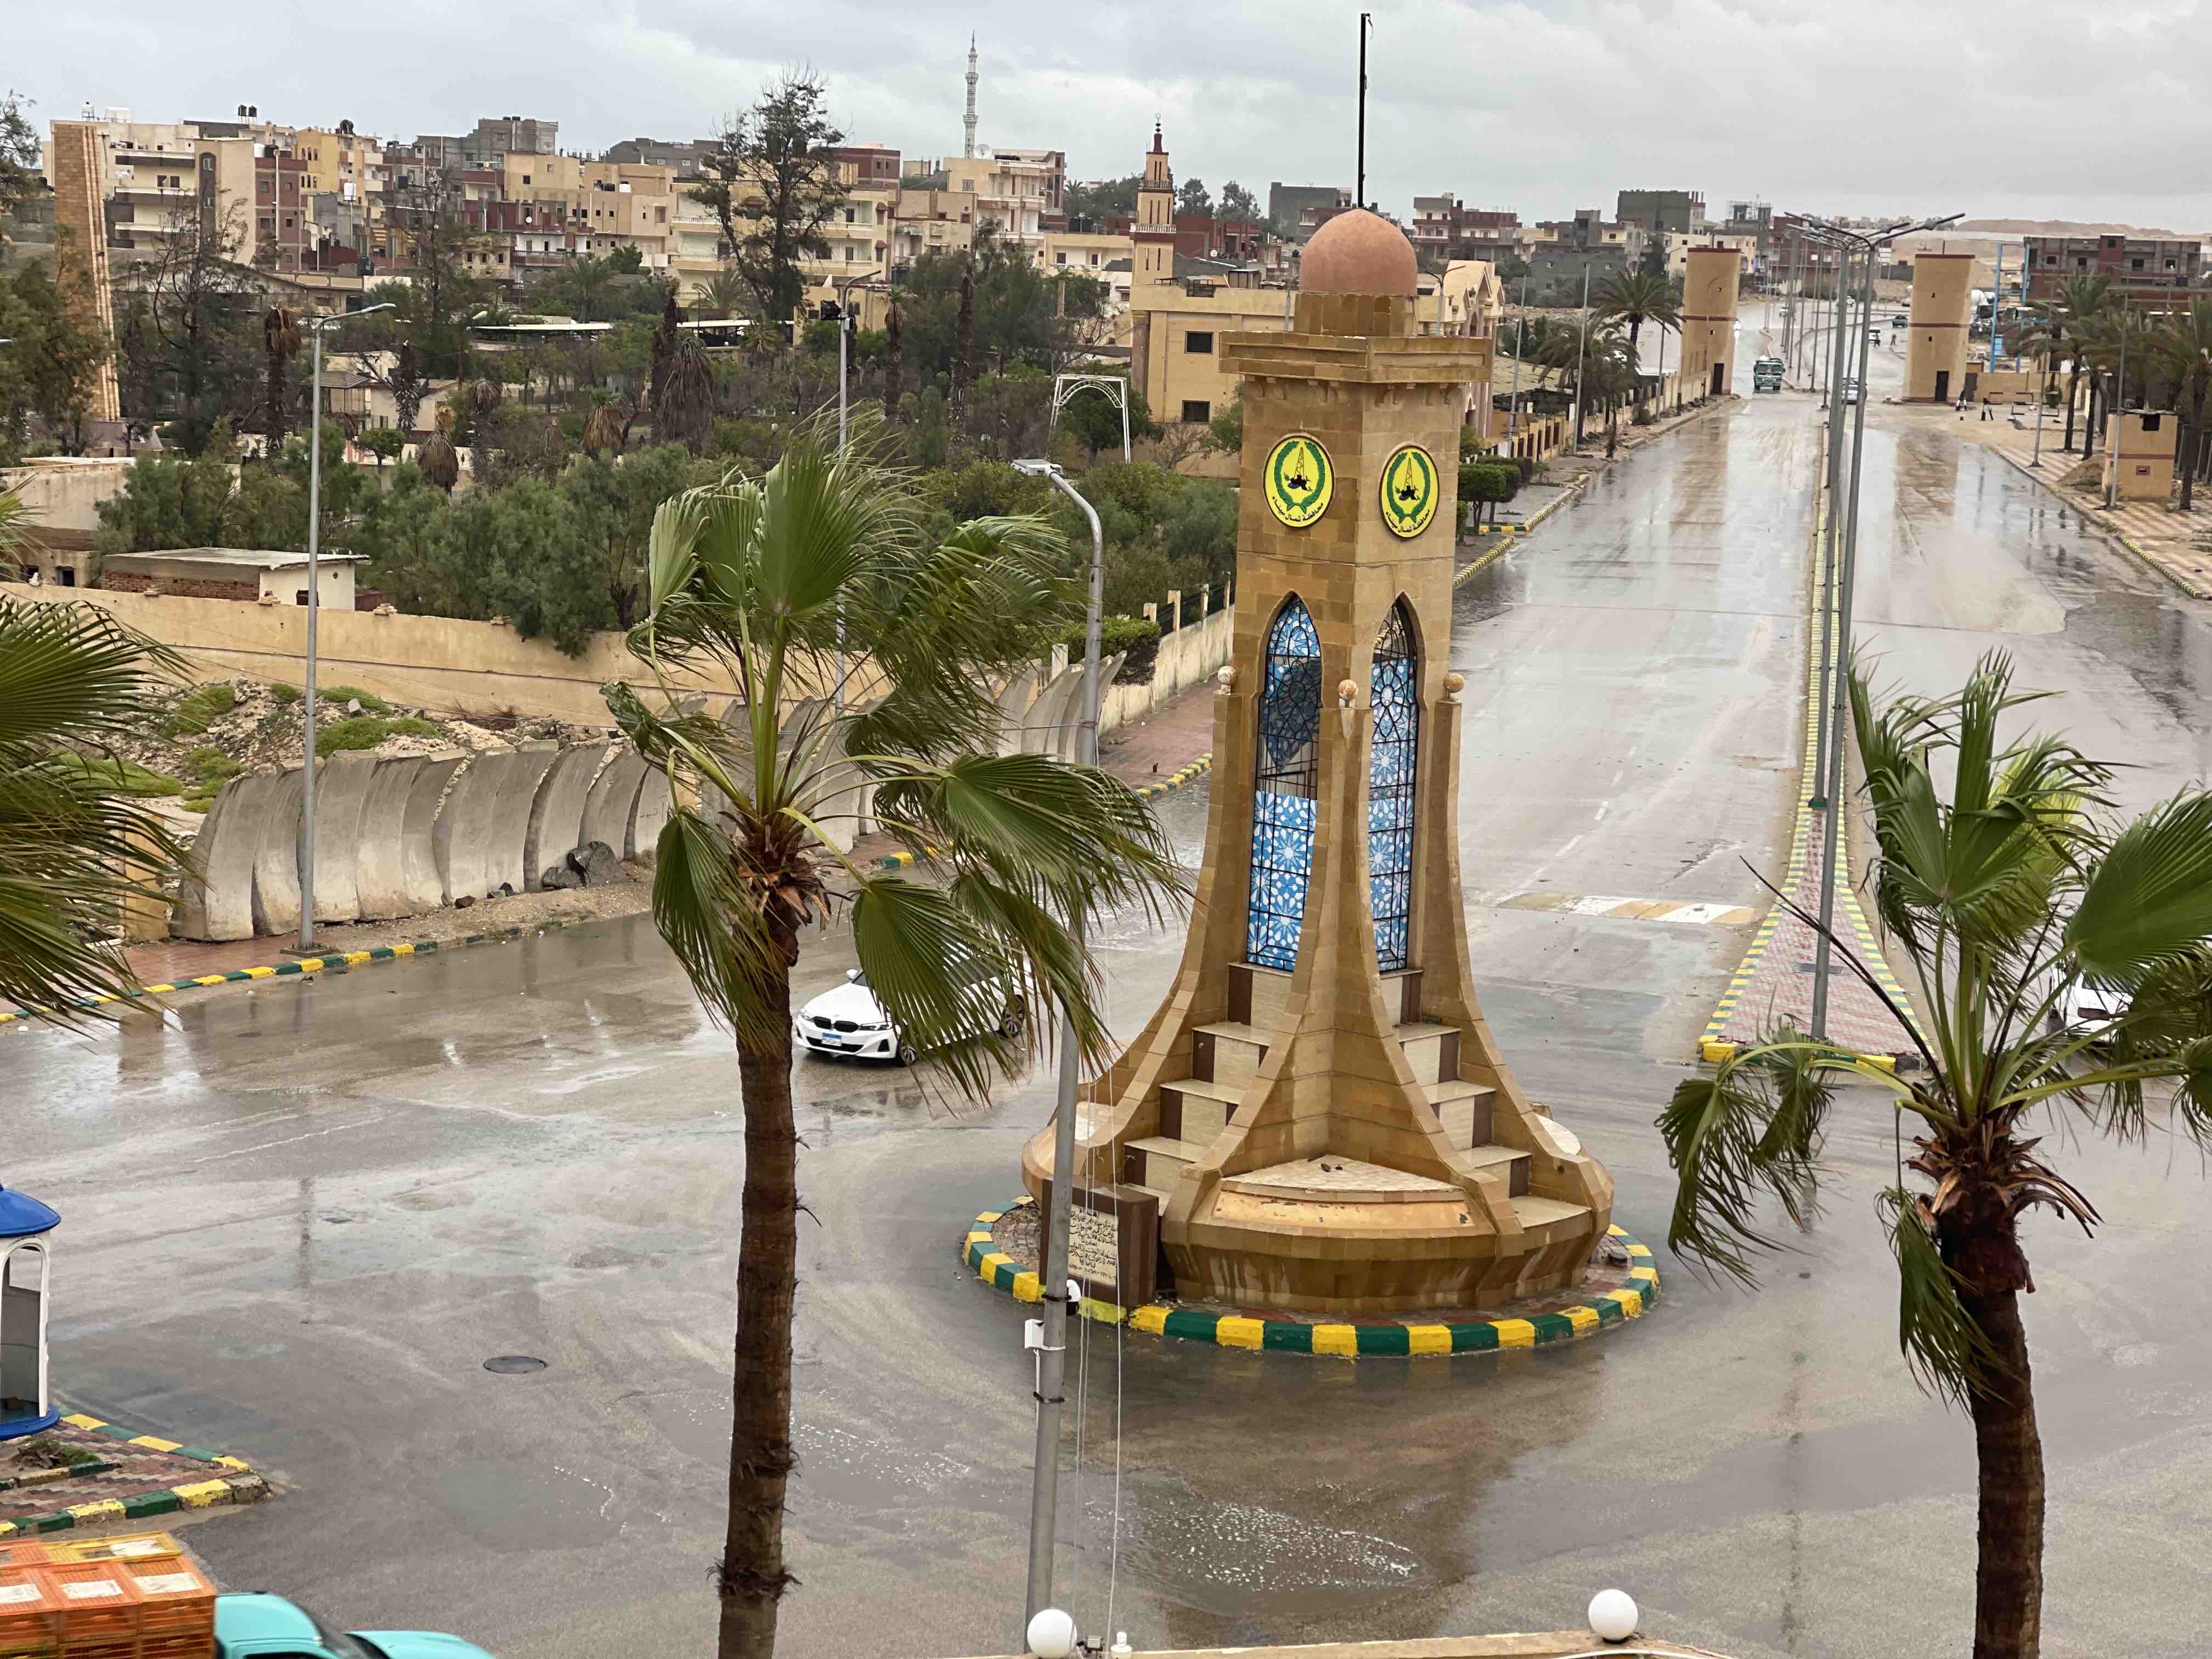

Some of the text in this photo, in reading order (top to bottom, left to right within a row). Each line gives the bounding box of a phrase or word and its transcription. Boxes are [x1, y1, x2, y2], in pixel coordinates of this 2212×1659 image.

[1272, 496, 1323, 522] محافظة شمال سيناء
[1413, 509, 1430, 531] محافظة
[1386, 512, 1398, 529] سيناء
